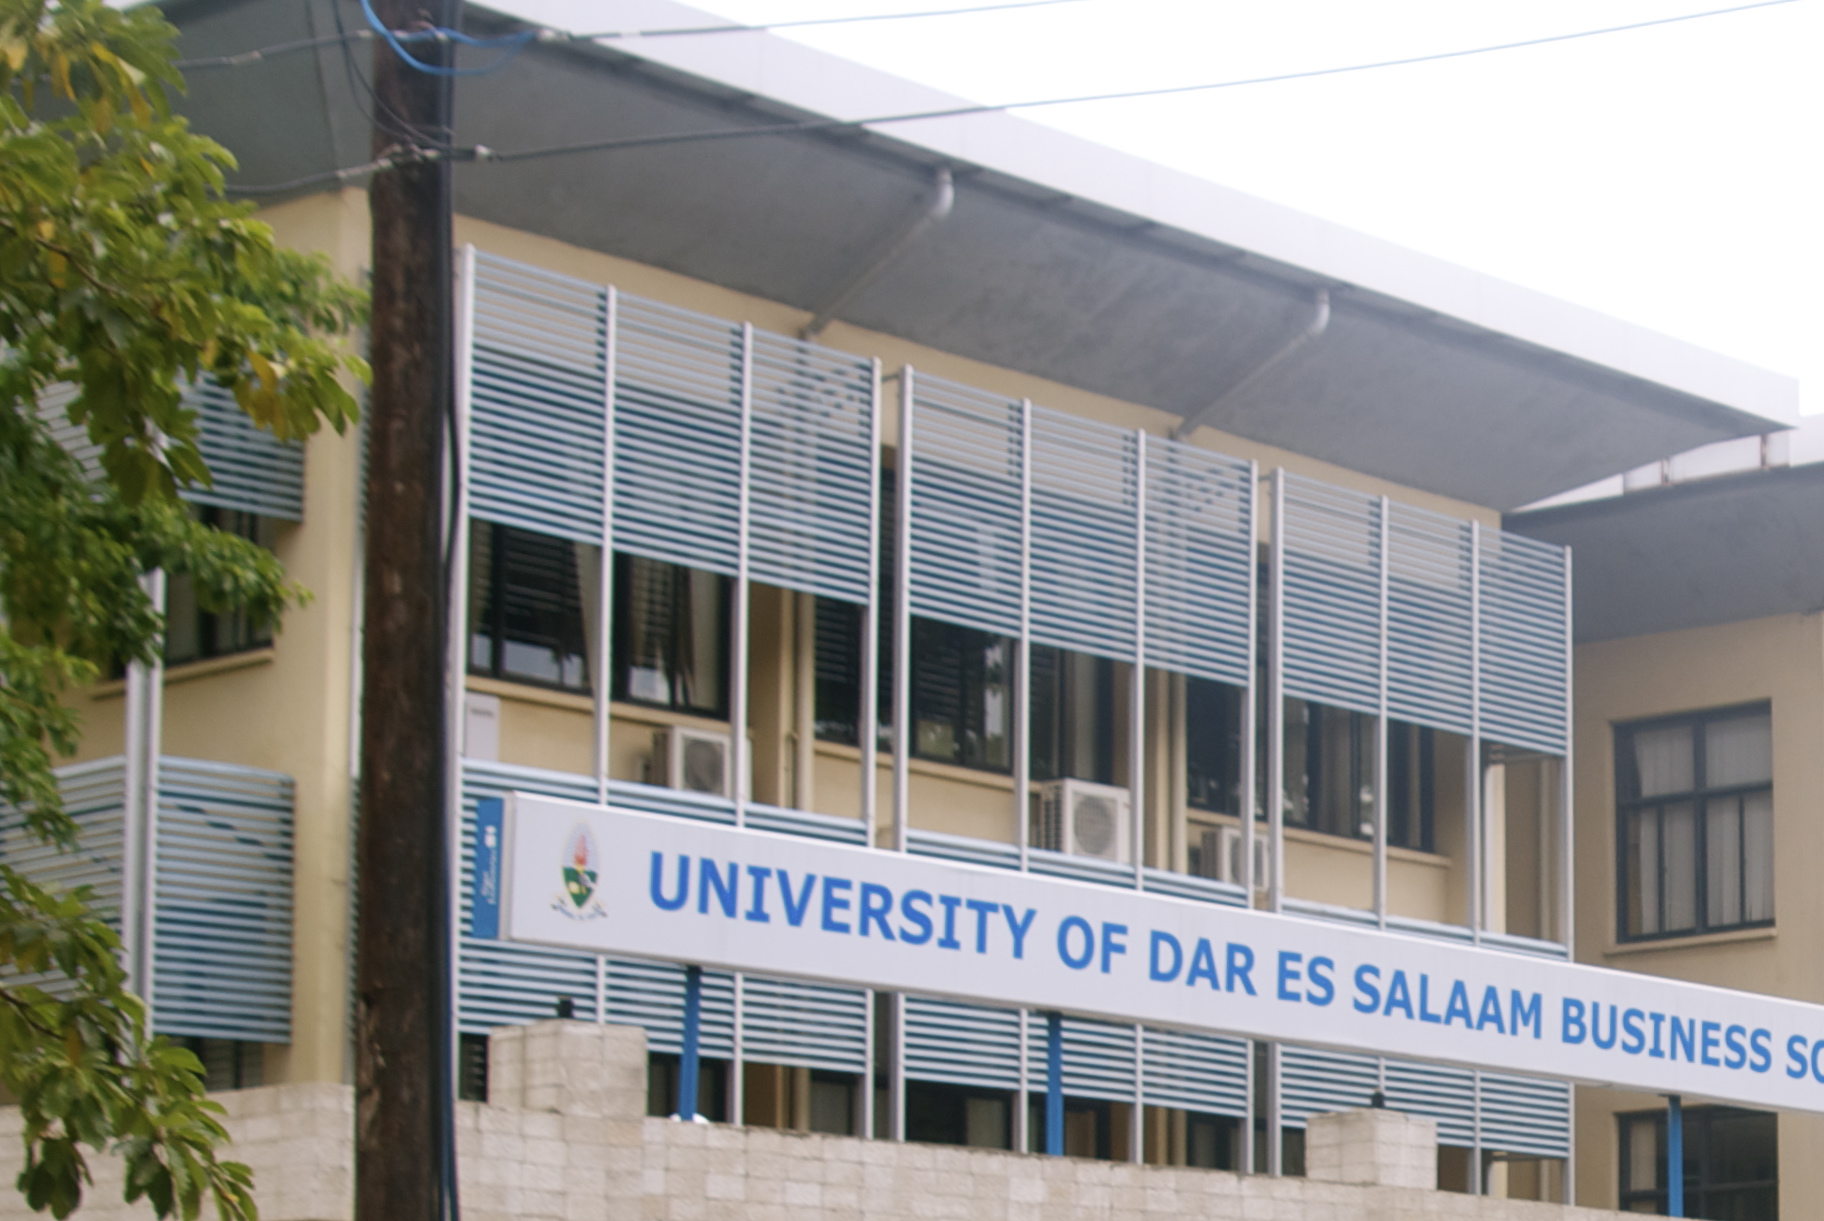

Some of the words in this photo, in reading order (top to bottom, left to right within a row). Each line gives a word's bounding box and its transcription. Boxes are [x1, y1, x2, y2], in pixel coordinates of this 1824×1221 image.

[649, 851, 1037, 961] UNIVERSITY
[1056, 915, 1129, 974] OF
[1148, 929, 1257, 997] DAR
[1276, 950, 1335, 1007] ES
[1351, 963, 1542, 1040] SALAAM
[1560, 997, 1773, 1073] BUSINESS
